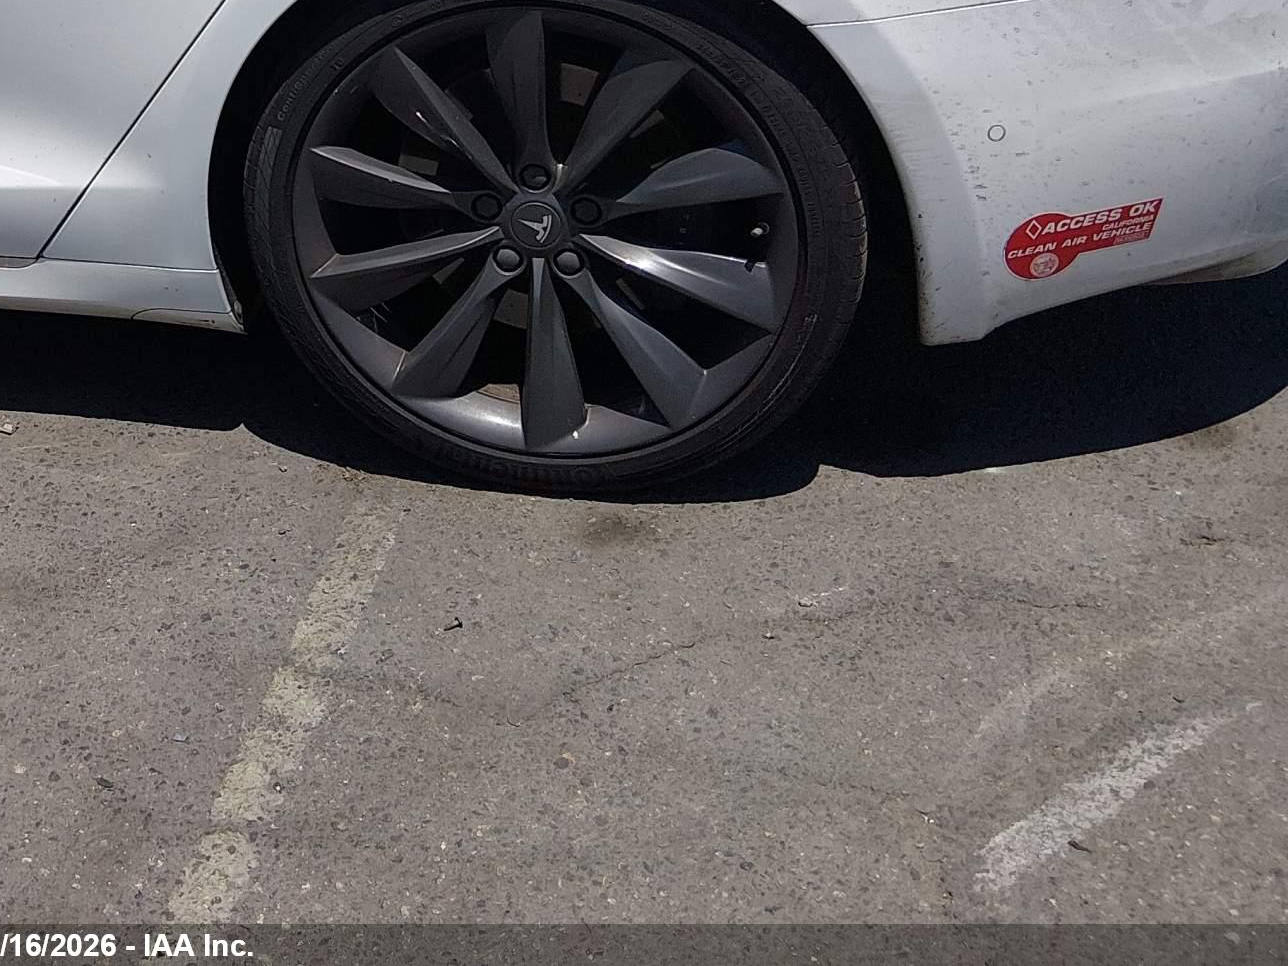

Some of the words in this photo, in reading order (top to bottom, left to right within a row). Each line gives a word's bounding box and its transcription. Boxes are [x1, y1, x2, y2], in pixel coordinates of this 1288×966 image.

[1041, 209, 1122, 235] ACCESS
[1128, 200, 1160, 217] OK
[1102, 214, 1155, 231] CALIFORNIA
[1007, 243, 1057, 259] CLEAN
[1062, 235, 1088, 248] AIR
[1092, 221, 1153, 241] VEHICLE
